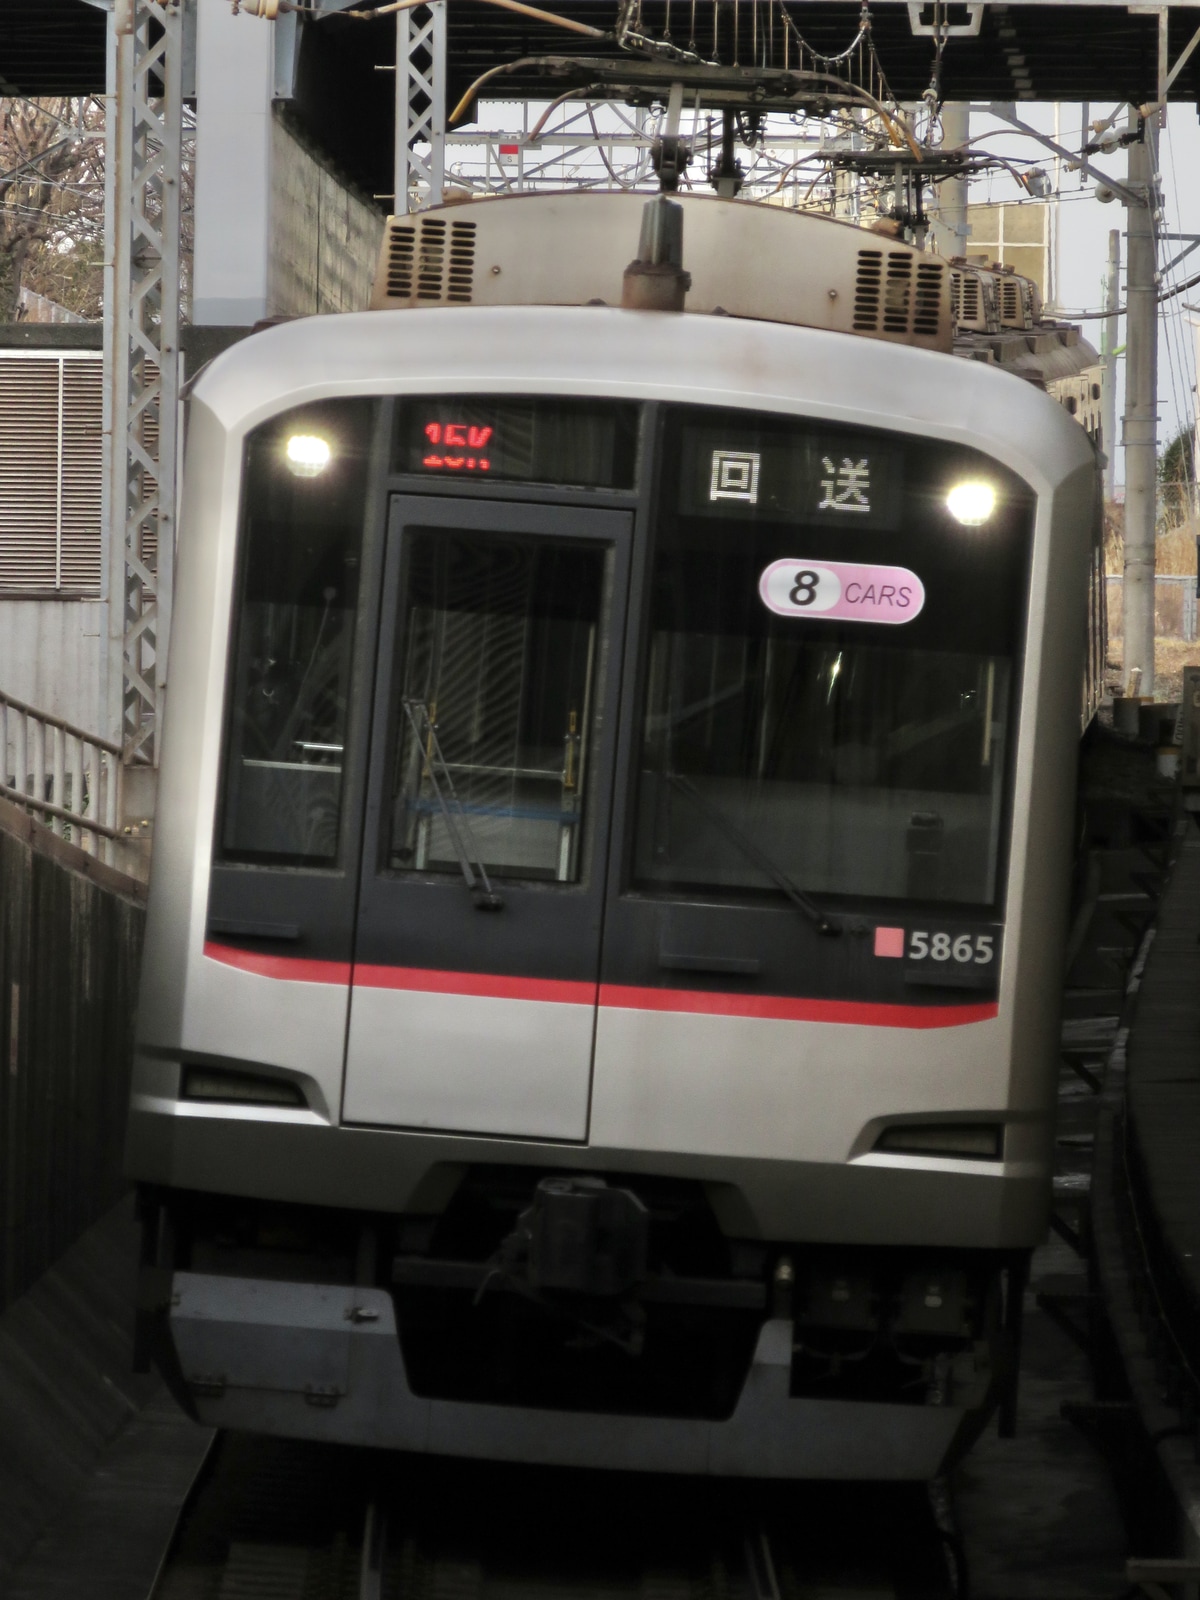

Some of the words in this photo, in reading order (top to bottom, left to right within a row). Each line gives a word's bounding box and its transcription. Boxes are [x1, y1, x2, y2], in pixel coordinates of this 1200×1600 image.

[710, 450, 870, 512] 回送
[789, 570, 820, 606] 8
[845, 582, 912, 608] CARS
[908, 931, 994, 964] 5865
